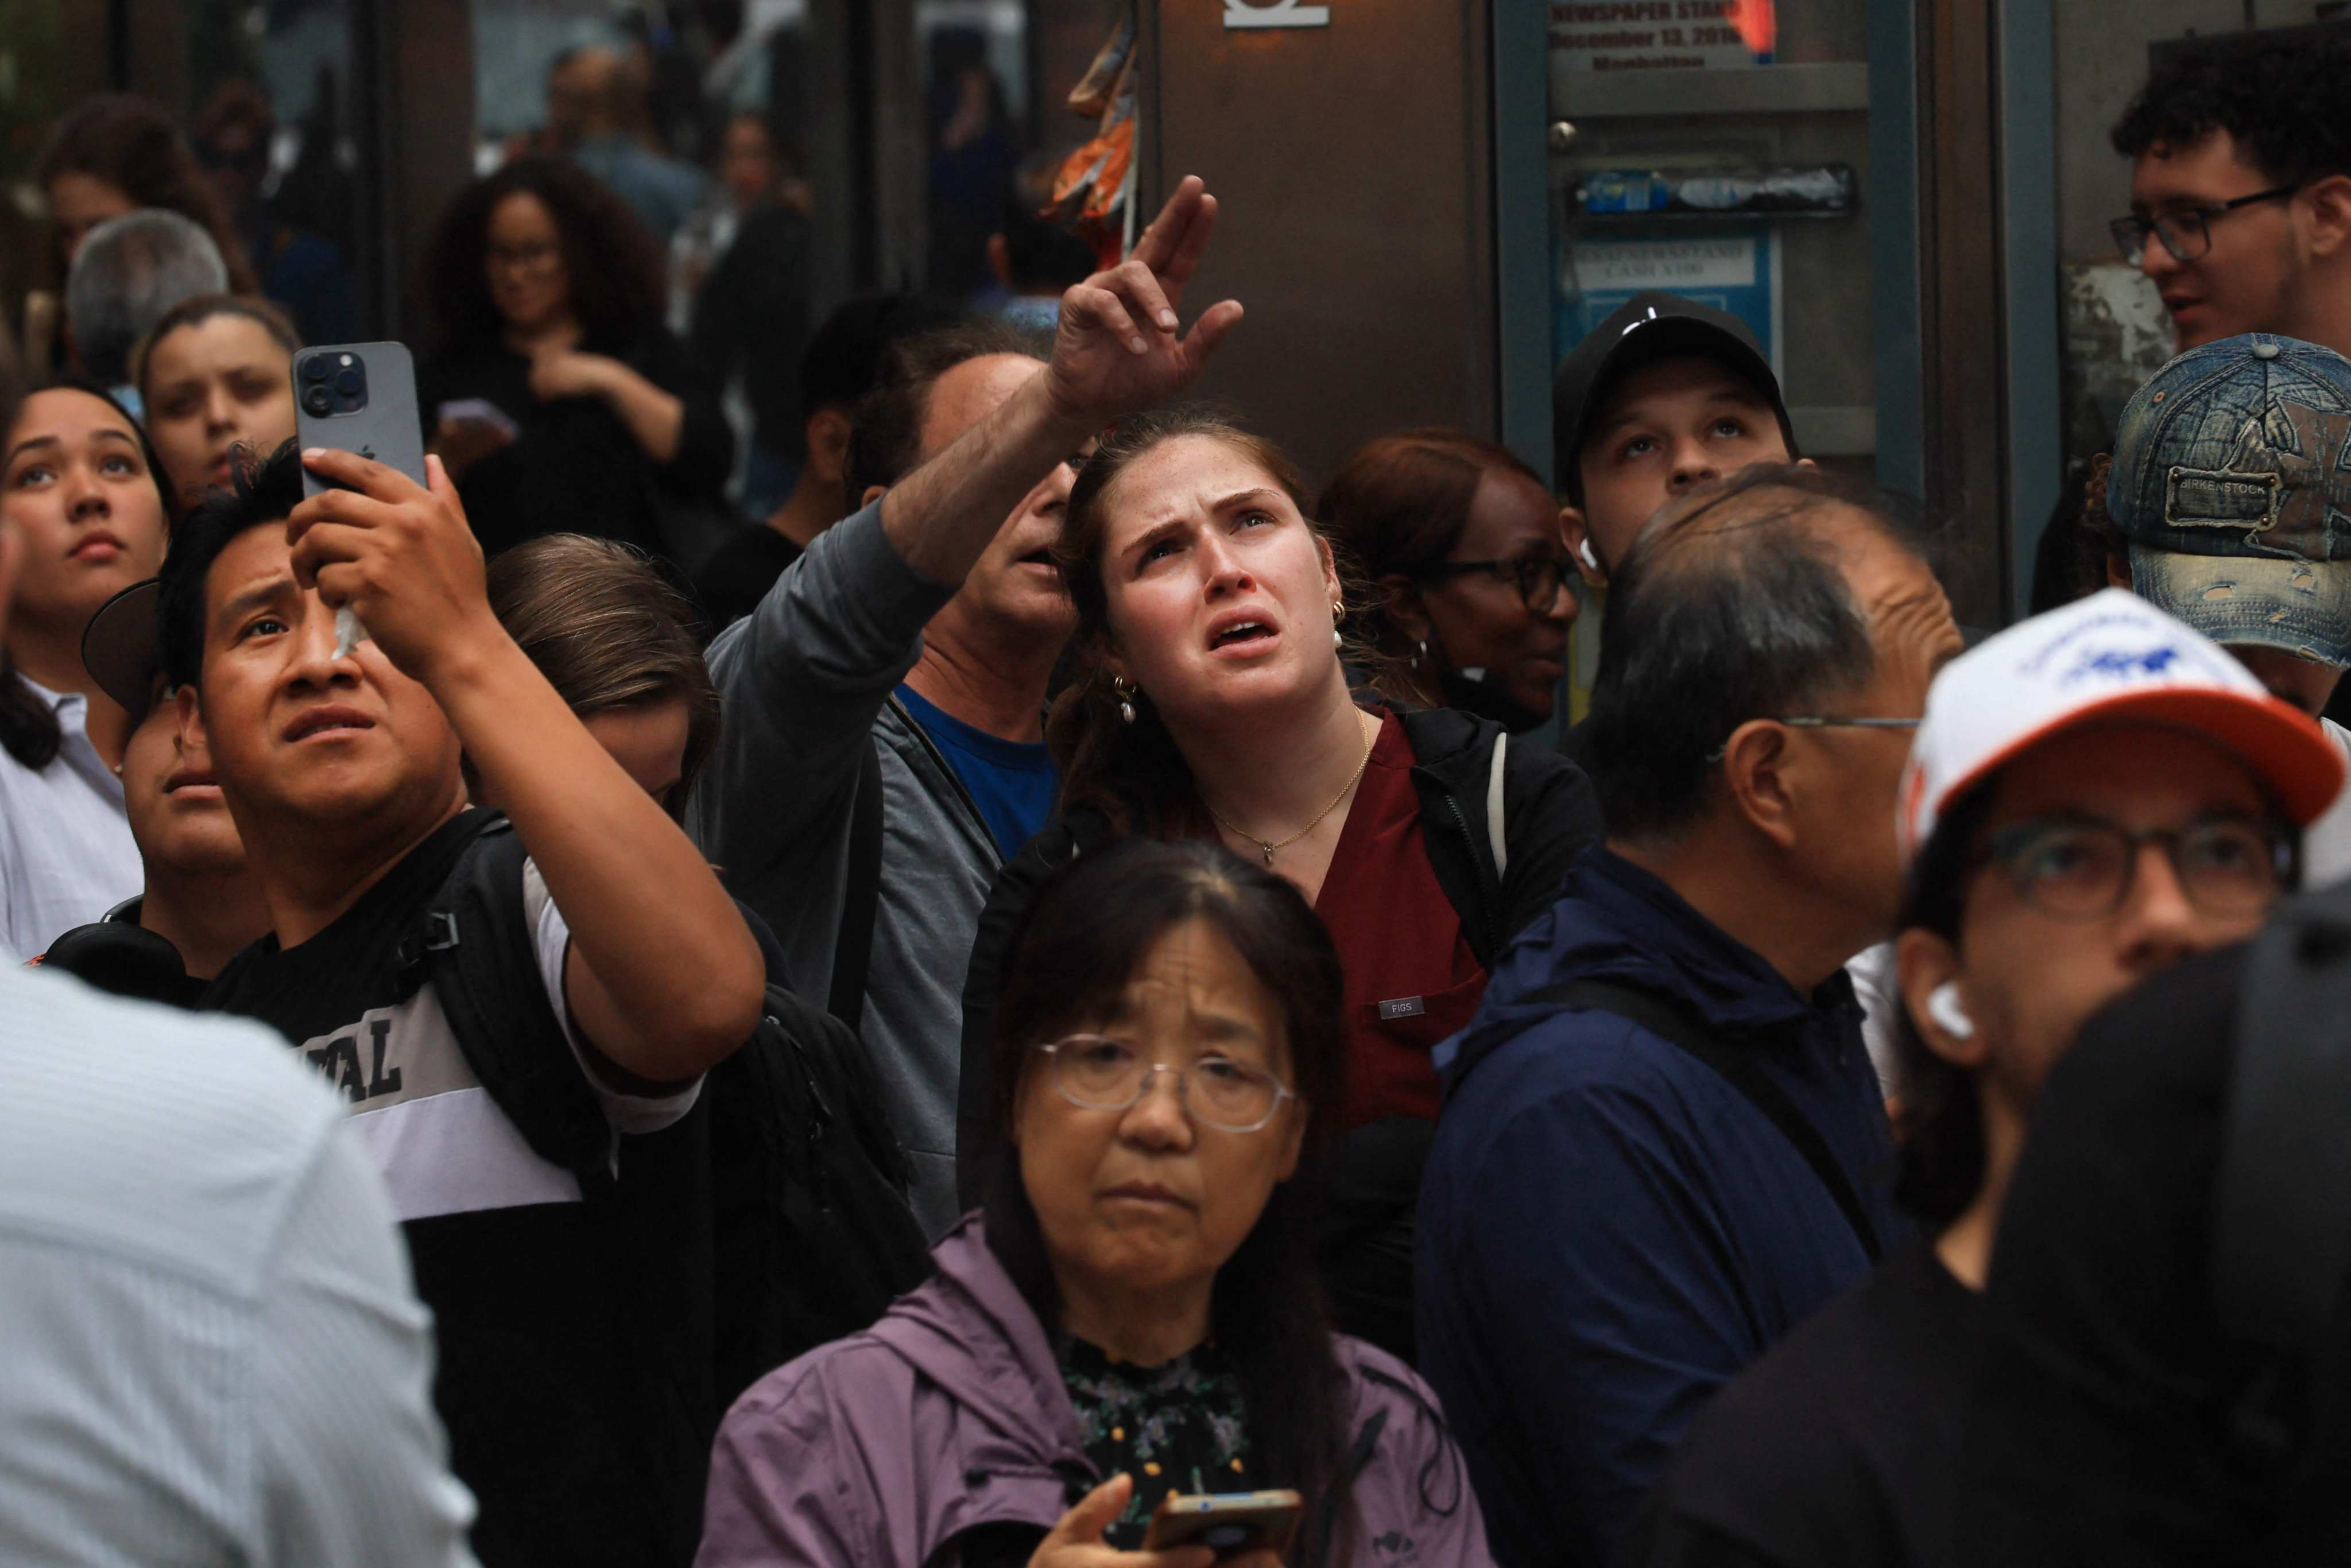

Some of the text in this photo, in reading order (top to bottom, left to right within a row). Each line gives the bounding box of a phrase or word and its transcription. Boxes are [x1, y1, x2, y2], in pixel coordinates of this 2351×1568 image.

[1551, 2, 1672, 22] NEWSPAPER
[1547, 30, 1653, 49] December
[2180, 478, 2265, 495] BIRKENSTOCK
[1391, 1002, 1412, 1013] FIGS
[305, 1019, 402, 1104] TAL
